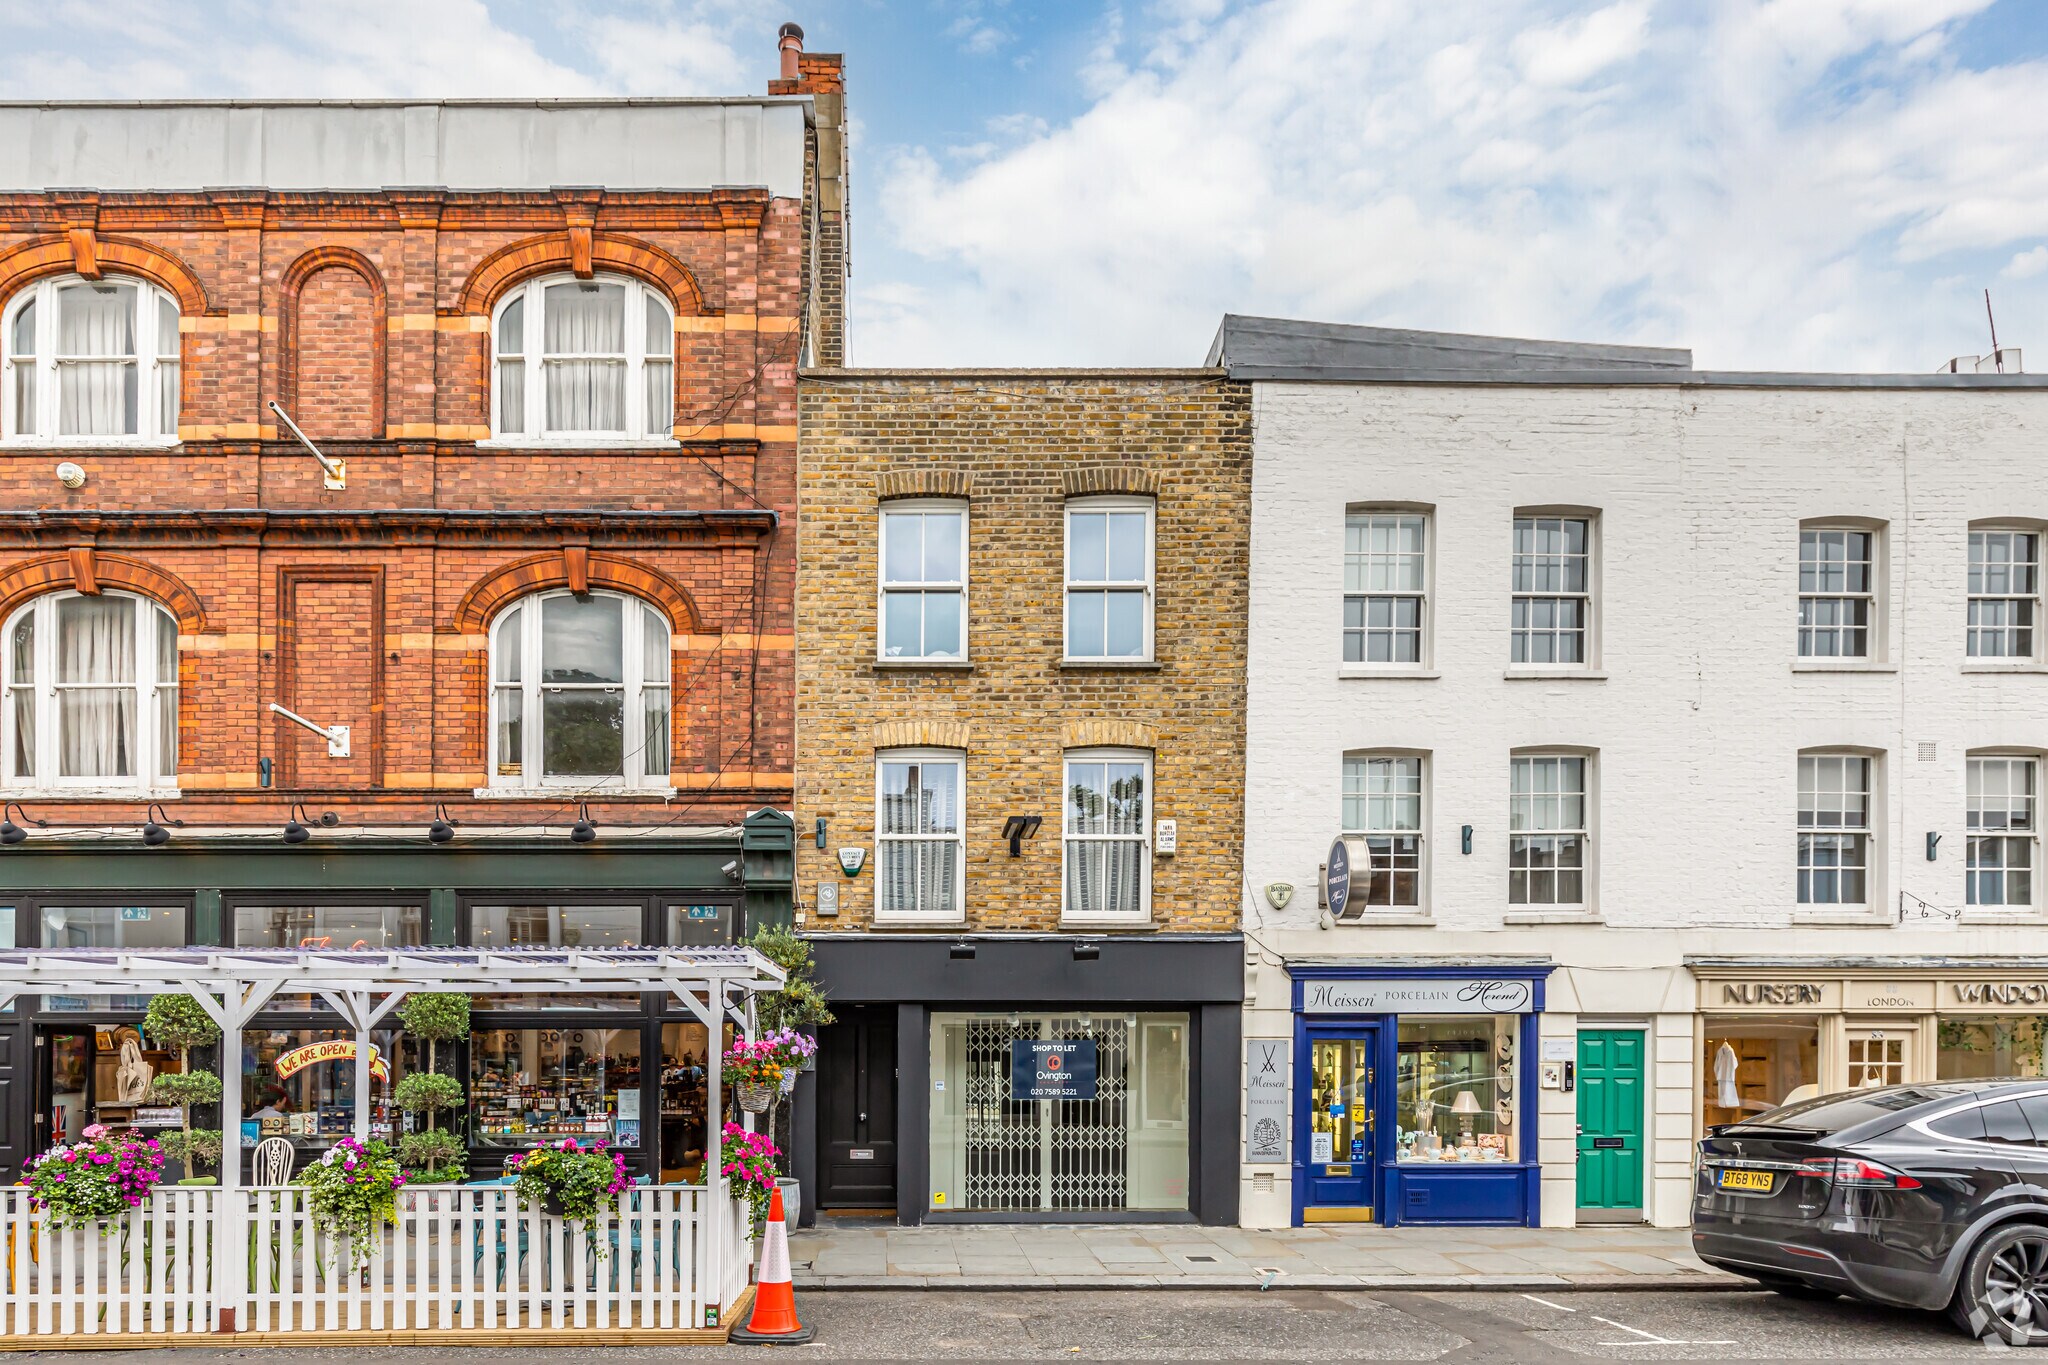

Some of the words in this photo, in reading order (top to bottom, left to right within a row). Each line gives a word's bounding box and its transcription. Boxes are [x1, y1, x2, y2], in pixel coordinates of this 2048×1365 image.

[1328, 874, 1348, 886] PORCELAIN
[1385, 991, 1449, 1001] PORCELAIN
[1723, 983, 1826, 1005] NURSERY
[1953, 984, 2048, 1005] WINDO
[1867, 997, 1914, 1007] LONDON
[281, 1058, 298, 1073] WE
[299, 1048, 317, 1065] ARE
[320, 1044, 347, 1057] OPEN
[1036, 1070, 1072, 1081] Ovington
[1250, 1075, 1285, 1088] Meissen
[1030, 1088, 1044, 1096] 020
[1045, 1088, 1060, 1096] 7589
[1062, 1088, 1077, 1096] 5221
[1723, 1171, 1749, 1185] BT68
[1751, 1173, 1771, 1187] YNS
